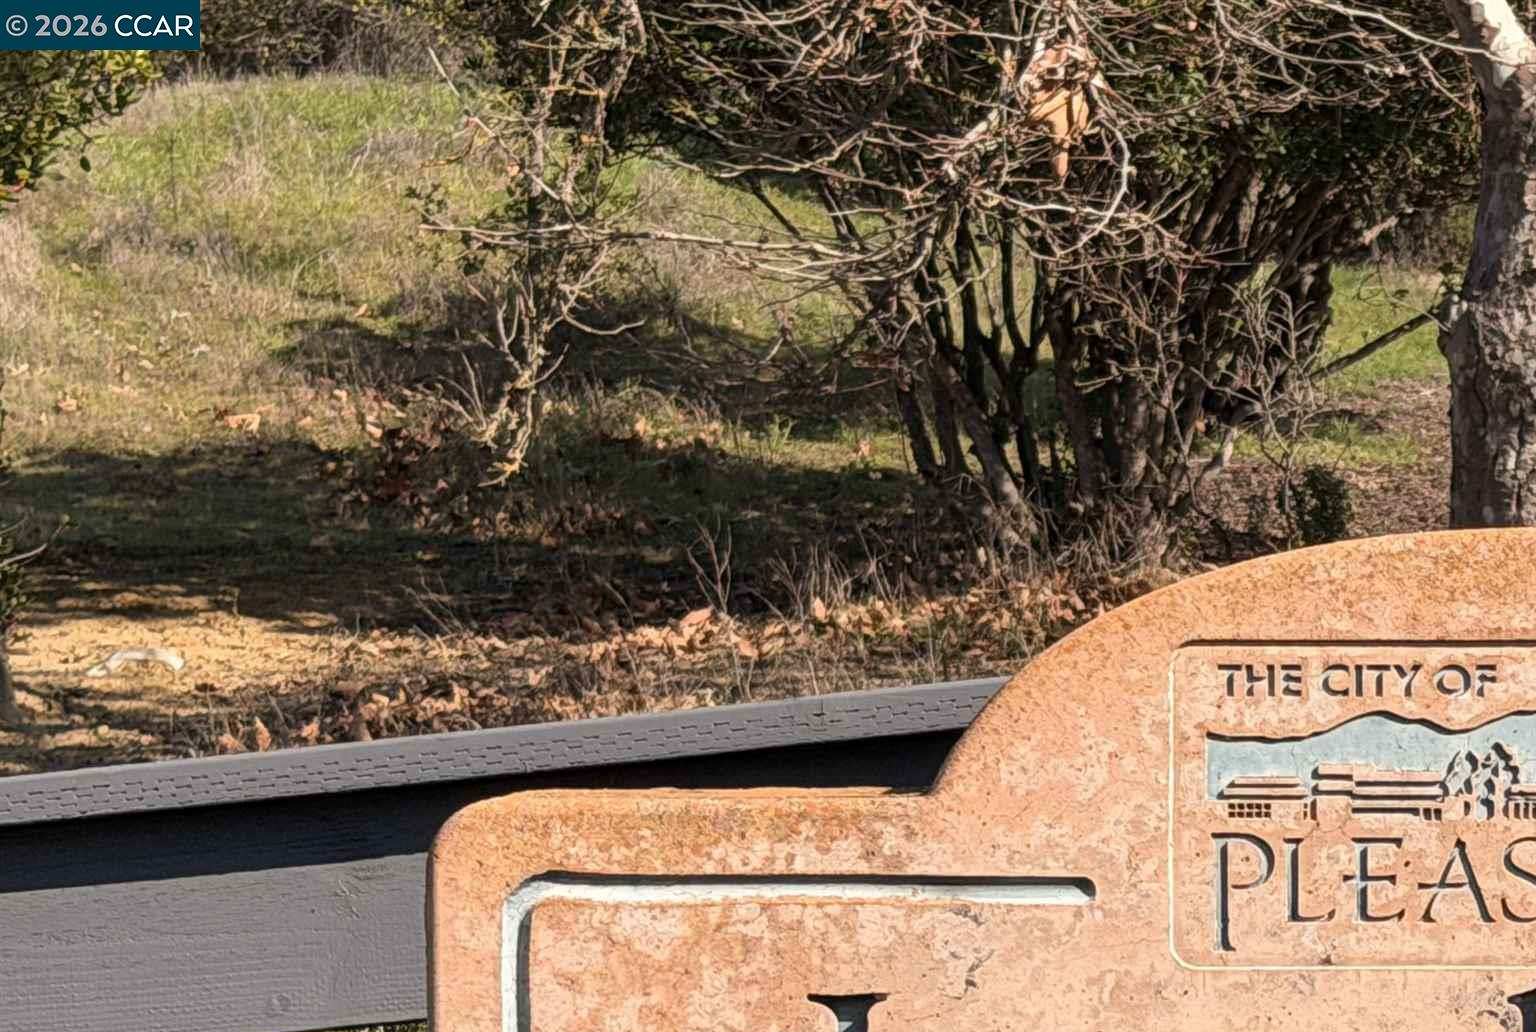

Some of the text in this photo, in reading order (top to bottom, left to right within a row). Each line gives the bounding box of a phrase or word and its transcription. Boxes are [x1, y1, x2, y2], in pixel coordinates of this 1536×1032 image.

[1217, 664, 1497, 698] THE CITY OF
